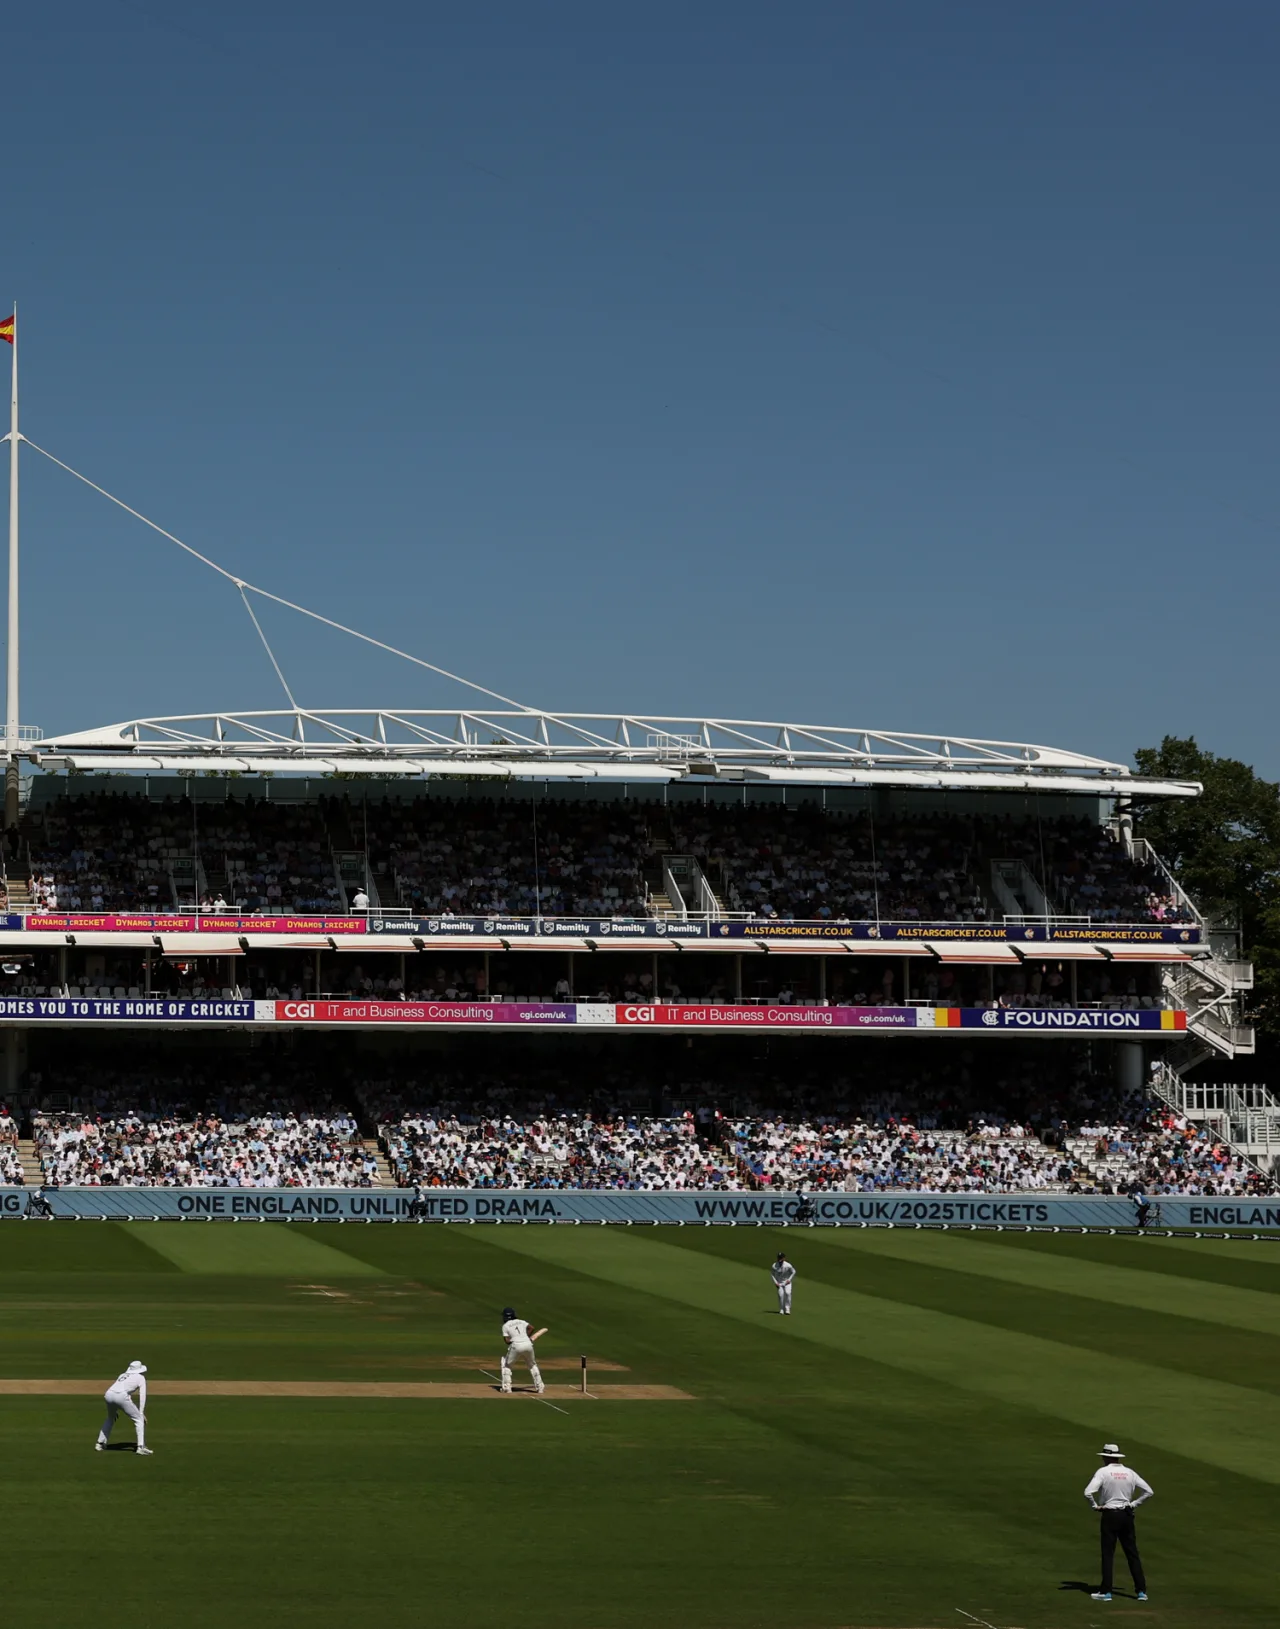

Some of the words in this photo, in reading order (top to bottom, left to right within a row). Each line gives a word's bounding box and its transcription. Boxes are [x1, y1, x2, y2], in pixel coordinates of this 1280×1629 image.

[31, 918, 67, 926] DYNAMOS
[69, 918, 105, 926] CRICKET
[154, 919, 189, 927] CRICKET
[203, 920, 238, 928] DYNAMOS
[241, 920, 277, 928] CRICKET
[324, 921, 360, 929] CRICKET
[385, 921, 419, 931] Remitly
[440, 922, 474, 932] Remitly
[496, 922, 529, 933] Remitly
[556, 923, 589, 934] Remitly
[612, 923, 645, 934] Remitly
[668, 924, 701, 935] Remitly
[744, 926, 853, 936] ALLSTARSCRICKET.CO.UK
[897, 927, 1007, 937] ALLSTARSCRICKET.CO.UK
[1053, 930, 1162, 940] ALLSTARSCRICKET.CO.UK
[39, 1002, 66, 1014] YOU
[71, 1003, 89, 1014] TO
[94, 1003, 121, 1015] THE
[126, 1003, 164, 1015] HOME
[168, 1004, 186, 1015] OF
[191, 1004, 250, 1016] CRICKET
[284, 1004, 315, 1018] CGI
[328, 1005, 339, 1016] IT
[343, 1005, 366, 1016] and
[370, 1006, 425, 1017] Business
[428, 1006, 494, 1021] Consulting
[520, 1009, 566, 1020] cgi.com/uk
[624, 1007, 655, 1021] CGI
[668, 1008, 679, 1020] IT
[683, 1009, 706, 1020] and
[710, 1009, 765, 1021] Business
[767, 1009, 833, 1025] Consulting
[859, 1013, 906, 1024] cgi.com/uk
[1004, 1011, 1140, 1027] FOUNDATION
[177, 1195, 225, 1213] ONE
[231, 1197, 344, 1214] ENGLAND.
[350, 1197, 469, 1216] UNLITED
[475, 1199, 562, 1217] DRAMA.
[694, 1201, 1049, 1222] WWW.EC.CO.UK/2025TICKETS
[514, 1326, 521, 1335] 1
